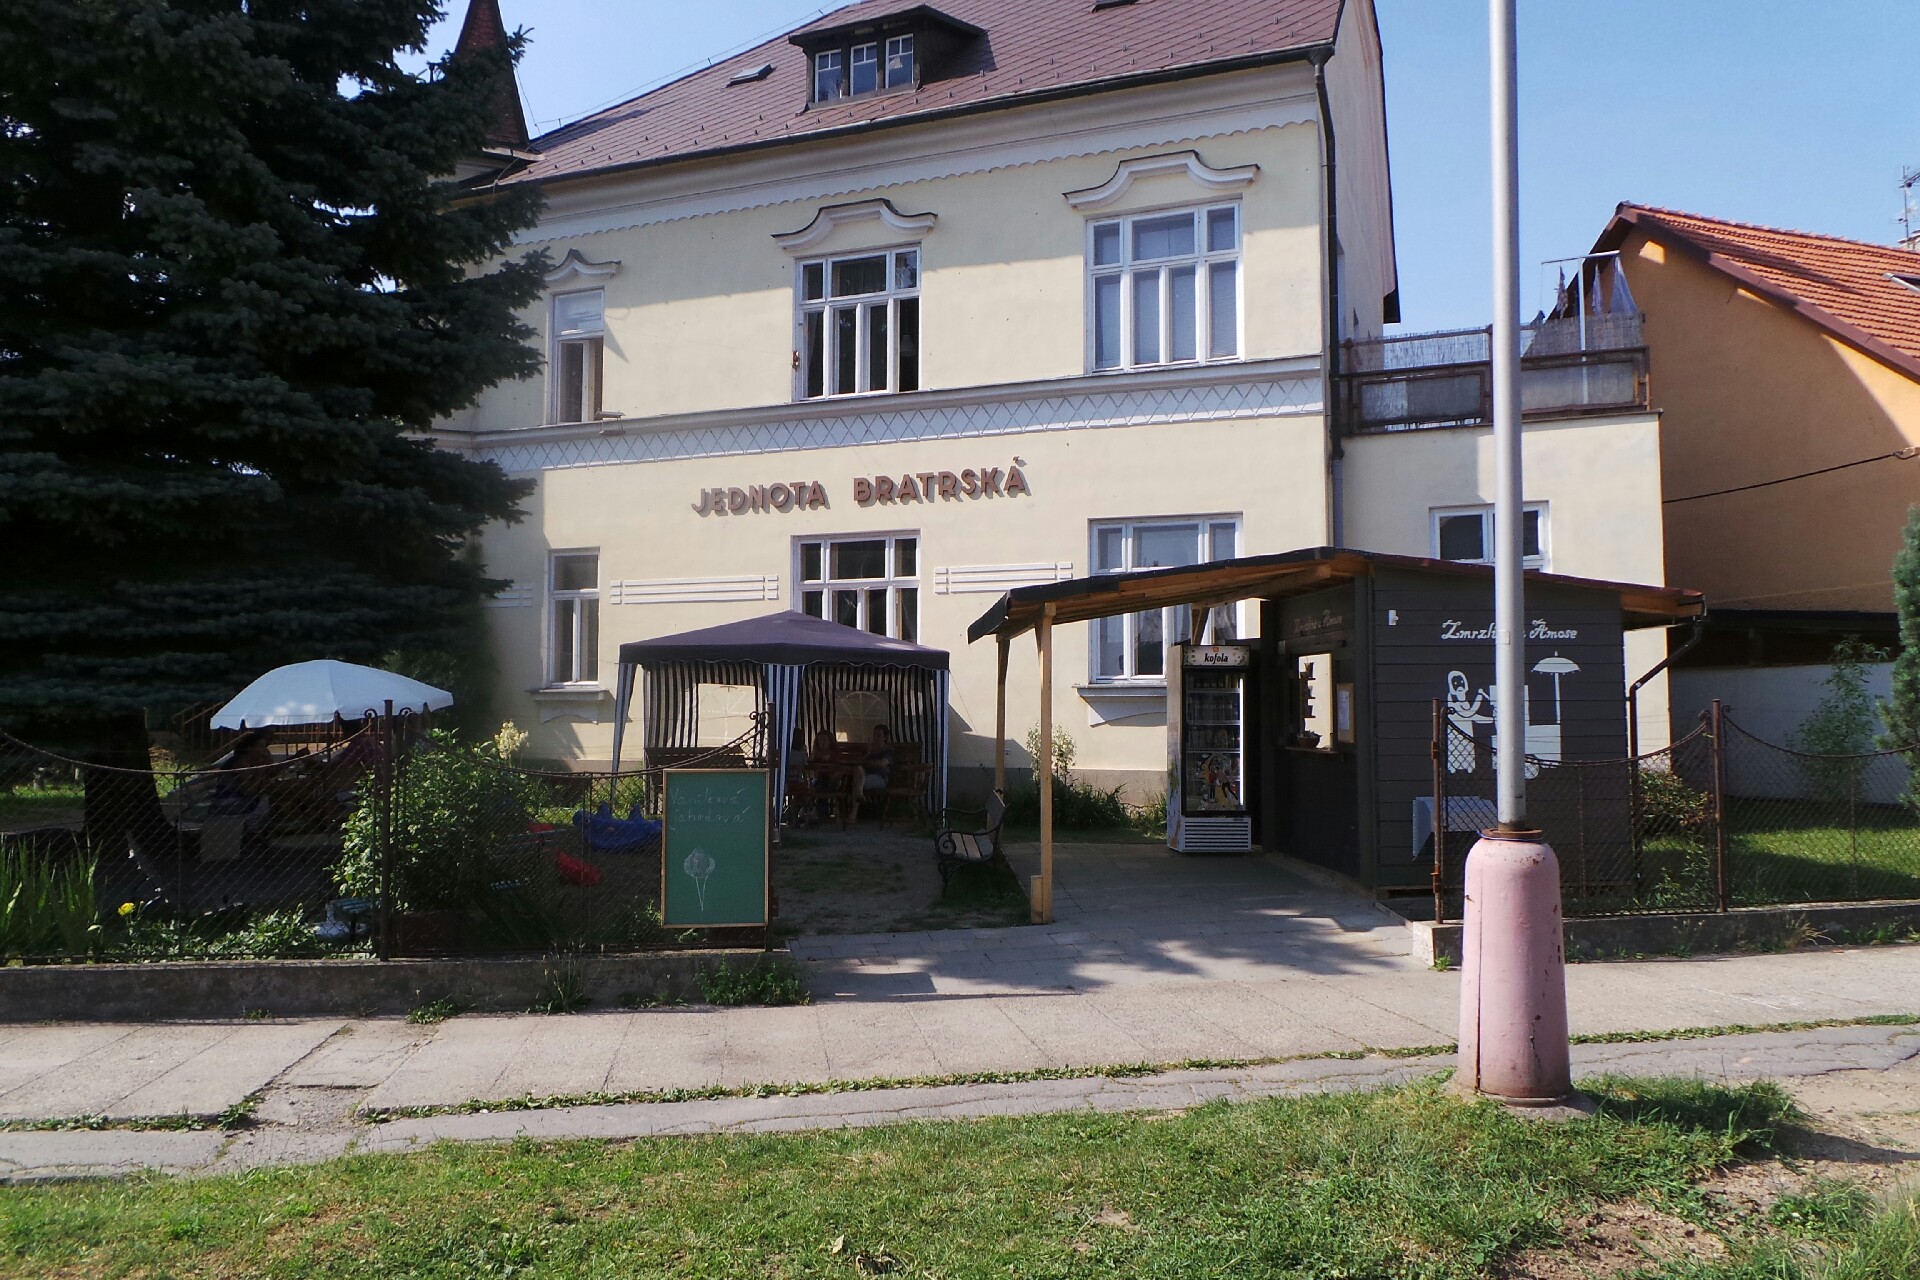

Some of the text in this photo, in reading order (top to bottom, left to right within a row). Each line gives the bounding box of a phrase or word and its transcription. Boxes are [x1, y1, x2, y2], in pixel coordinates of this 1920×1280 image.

[691, 456, 1027, 514] JEDNOTA BRATRSKÁ
[1441, 619, 1497, 640] Zmrzli
[1529, 618, 1578, 640] Amose
[1204, 652, 1229, 664] kofola
